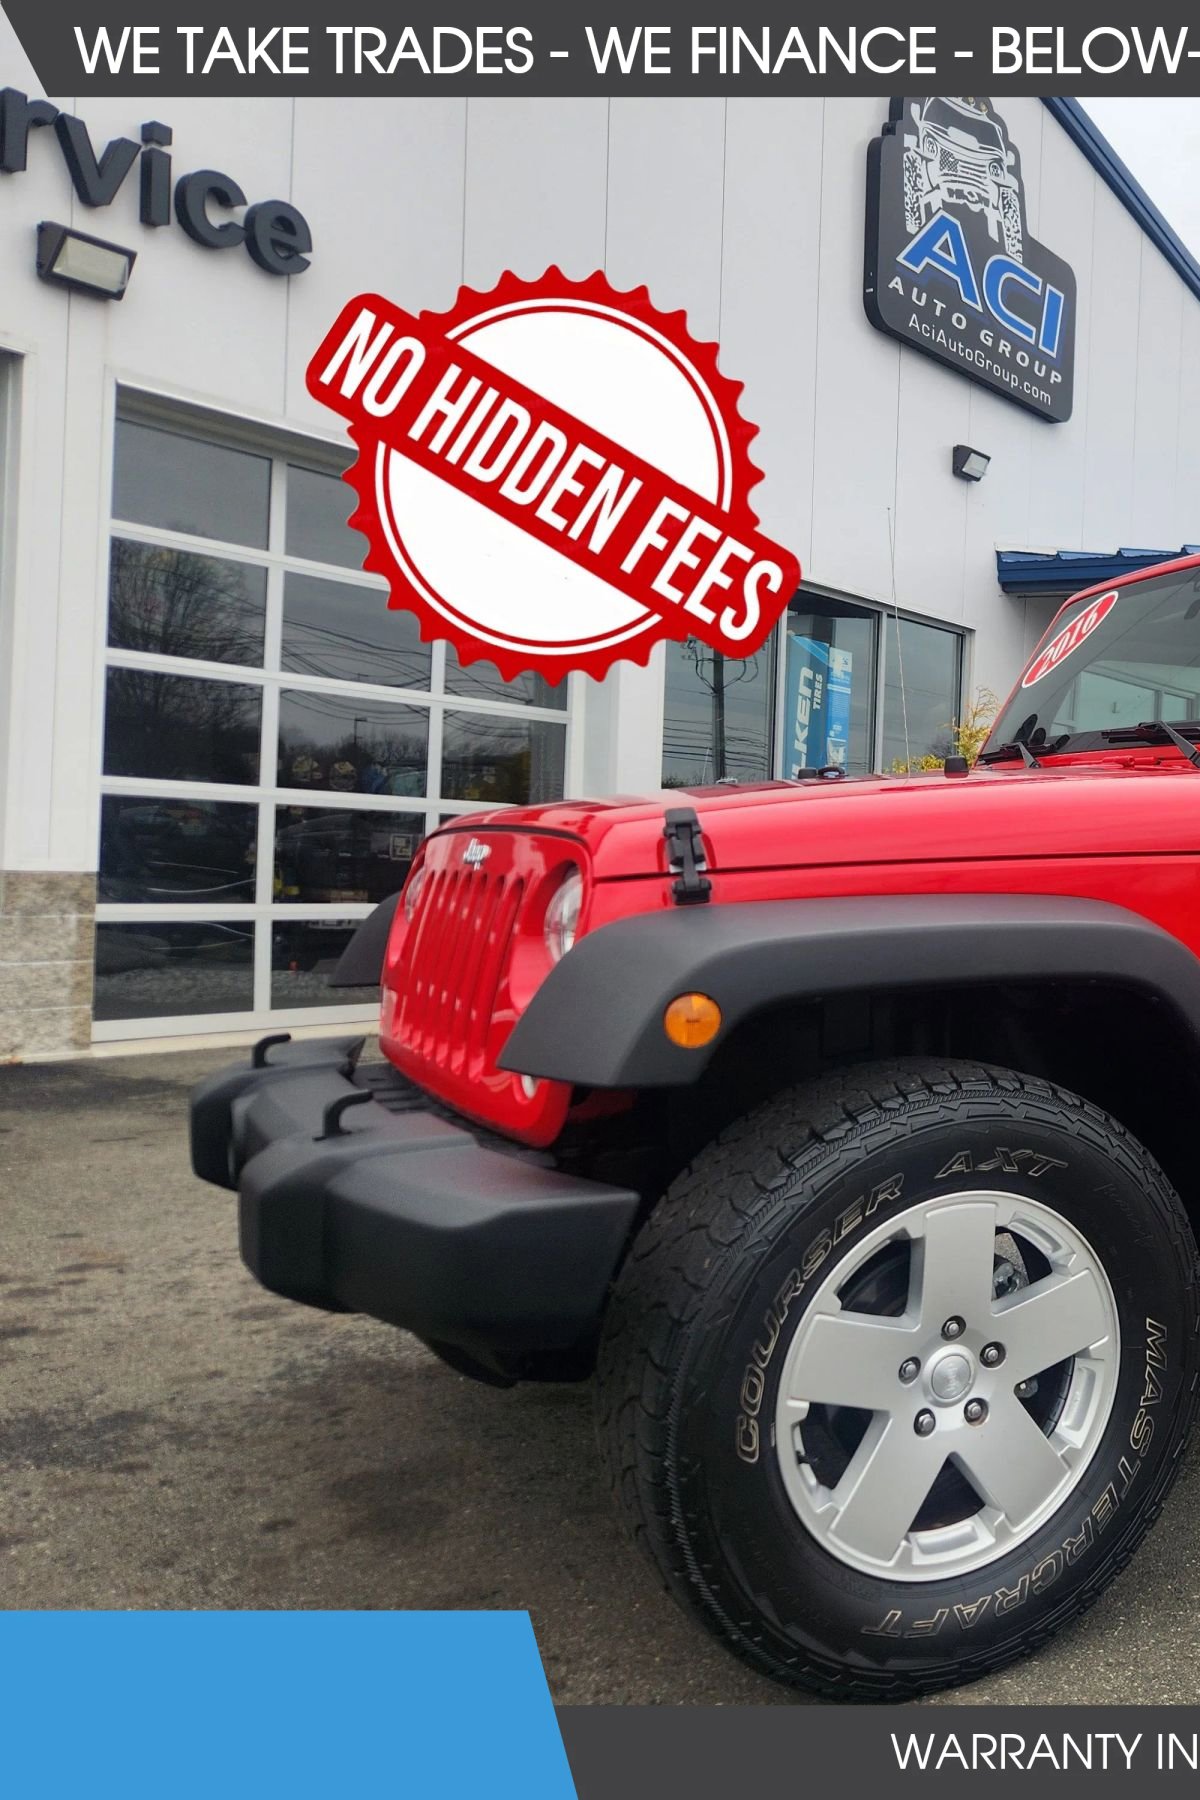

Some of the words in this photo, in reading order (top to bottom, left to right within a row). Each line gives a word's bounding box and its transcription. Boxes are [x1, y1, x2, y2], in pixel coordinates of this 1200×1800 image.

[888, 276, 967, 330] AUTO
[980, 331, 1062, 385] GROUP
[896, 207, 1065, 359] ACI
[908, 313, 1051, 405] AciAutoGroup.com
[813, 673, 823, 710] TIRES
[1034, 599, 1104, 681] 2016
[735, 1171, 904, 1464] COURSER
[935, 1146, 1069, 1178] AXT
[862, 1317, 1169, 1640] MASTERCRAFT
